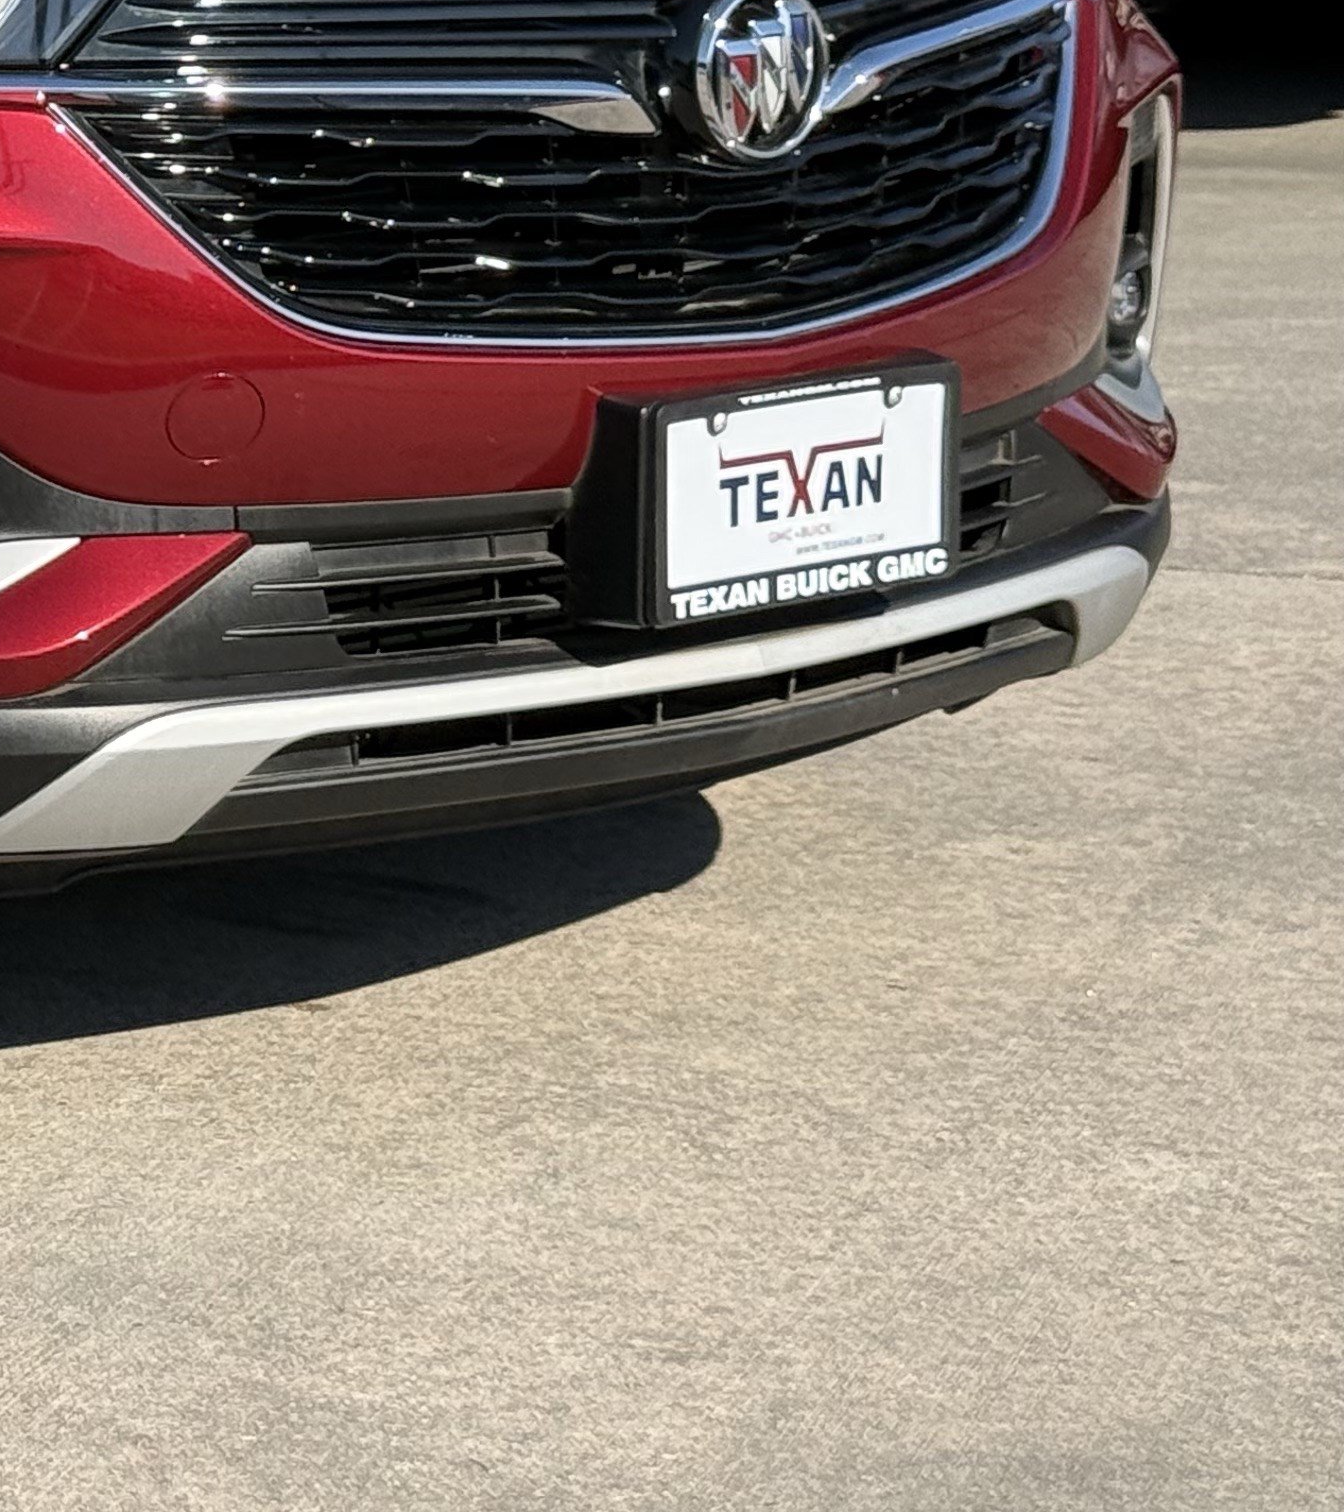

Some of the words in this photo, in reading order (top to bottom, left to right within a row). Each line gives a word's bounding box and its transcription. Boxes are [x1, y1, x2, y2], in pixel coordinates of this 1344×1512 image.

[718, 438, 885, 528] TEXAN
[671, 578, 769, 619] TEXAN
[776, 561, 872, 602] BUICK
[879, 548, 948, 582] GMC
